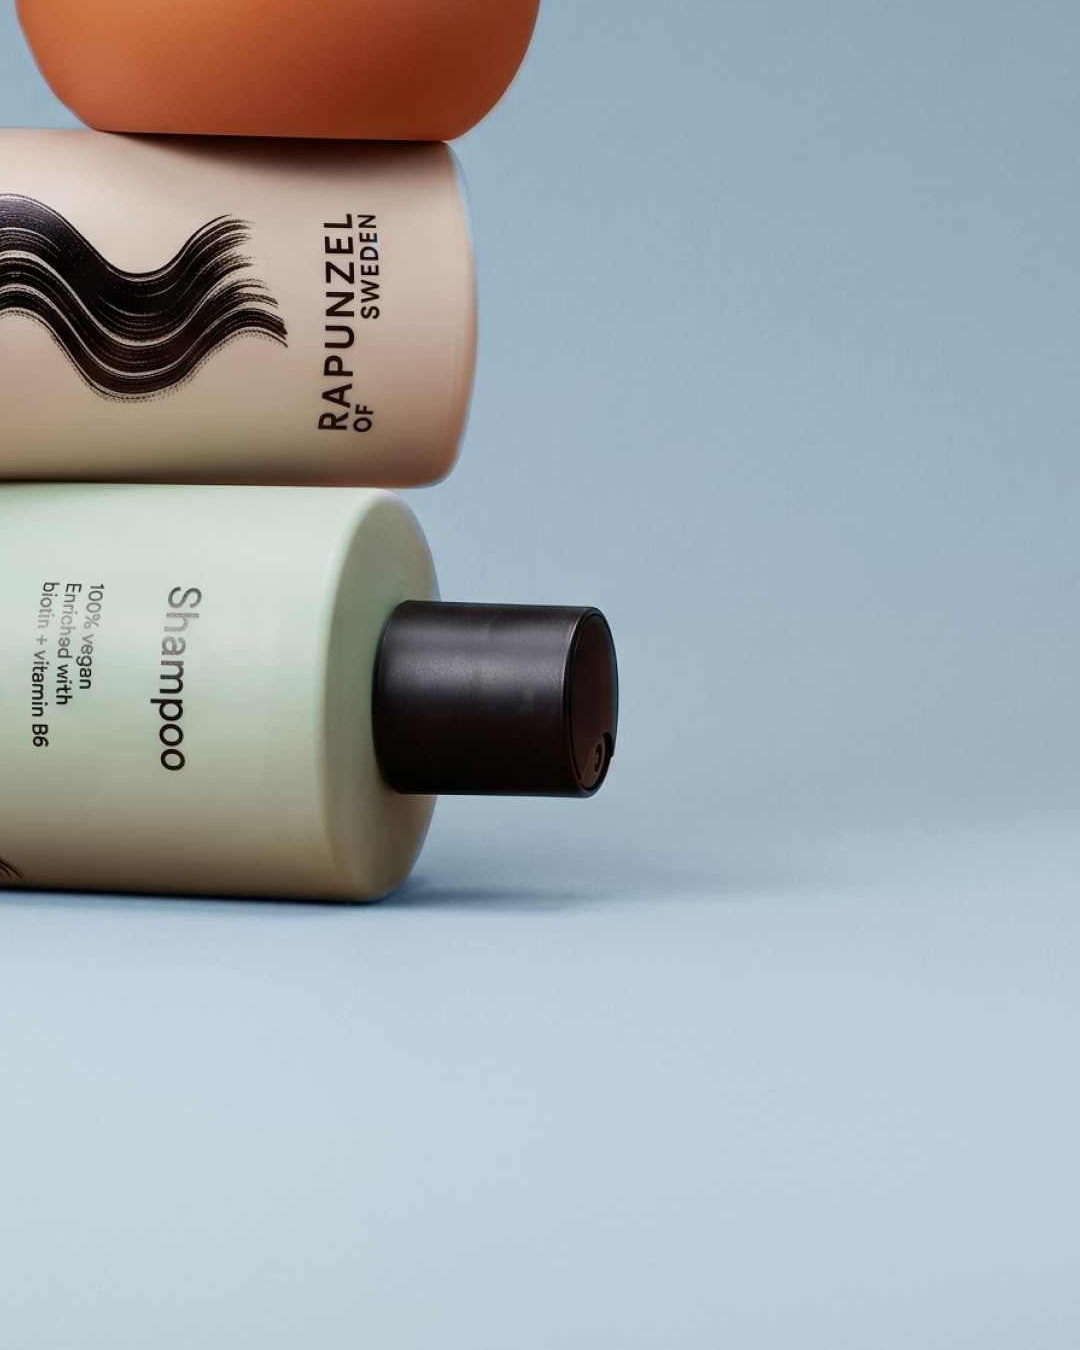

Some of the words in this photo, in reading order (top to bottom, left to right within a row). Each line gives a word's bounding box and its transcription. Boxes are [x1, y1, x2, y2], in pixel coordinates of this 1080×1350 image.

[357, 214, 380, 319] SWEDEN
[318, 213, 355, 430] RAPUNZEL
[353, 403, 374, 432] OF
[38, 582, 60, 629] biotin
[57, 583, 82, 659] Enriched
[83, 583, 105, 629] 100%
[36, 634, 48, 646] +
[76, 634, 94, 690] vegan
[31, 650, 50, 718] vitamin
[56, 664, 73, 706] with
[150, 586, 203, 772] Shampoo
[32, 724, 49, 748] B6
